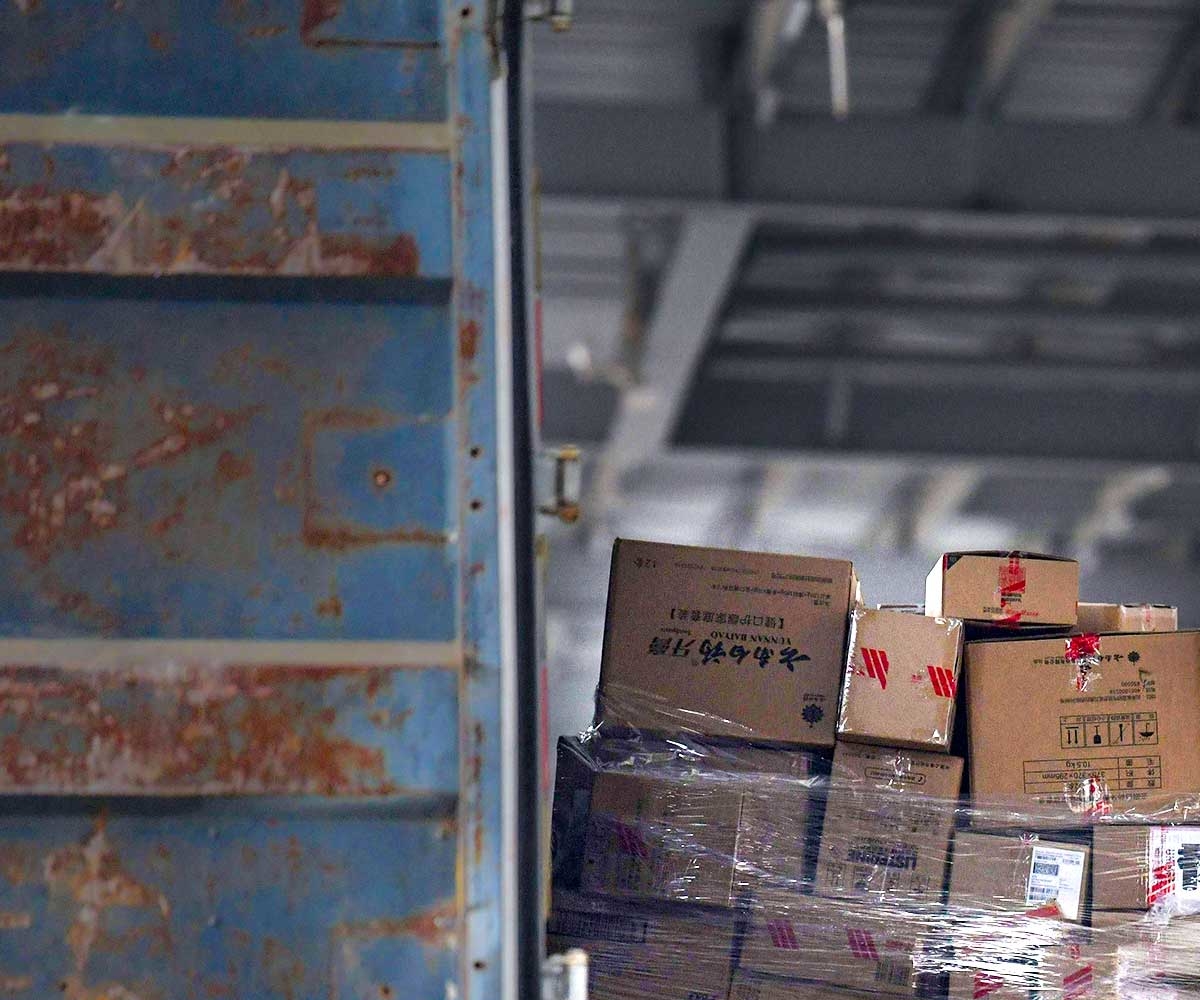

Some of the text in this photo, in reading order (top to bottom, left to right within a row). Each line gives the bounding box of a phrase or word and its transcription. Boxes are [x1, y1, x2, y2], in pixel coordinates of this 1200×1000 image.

[709, 631, 748, 643] BAIYAO
[749, 633, 792, 646] YUNNAN
[699, 638, 811, 673] 云南白药
